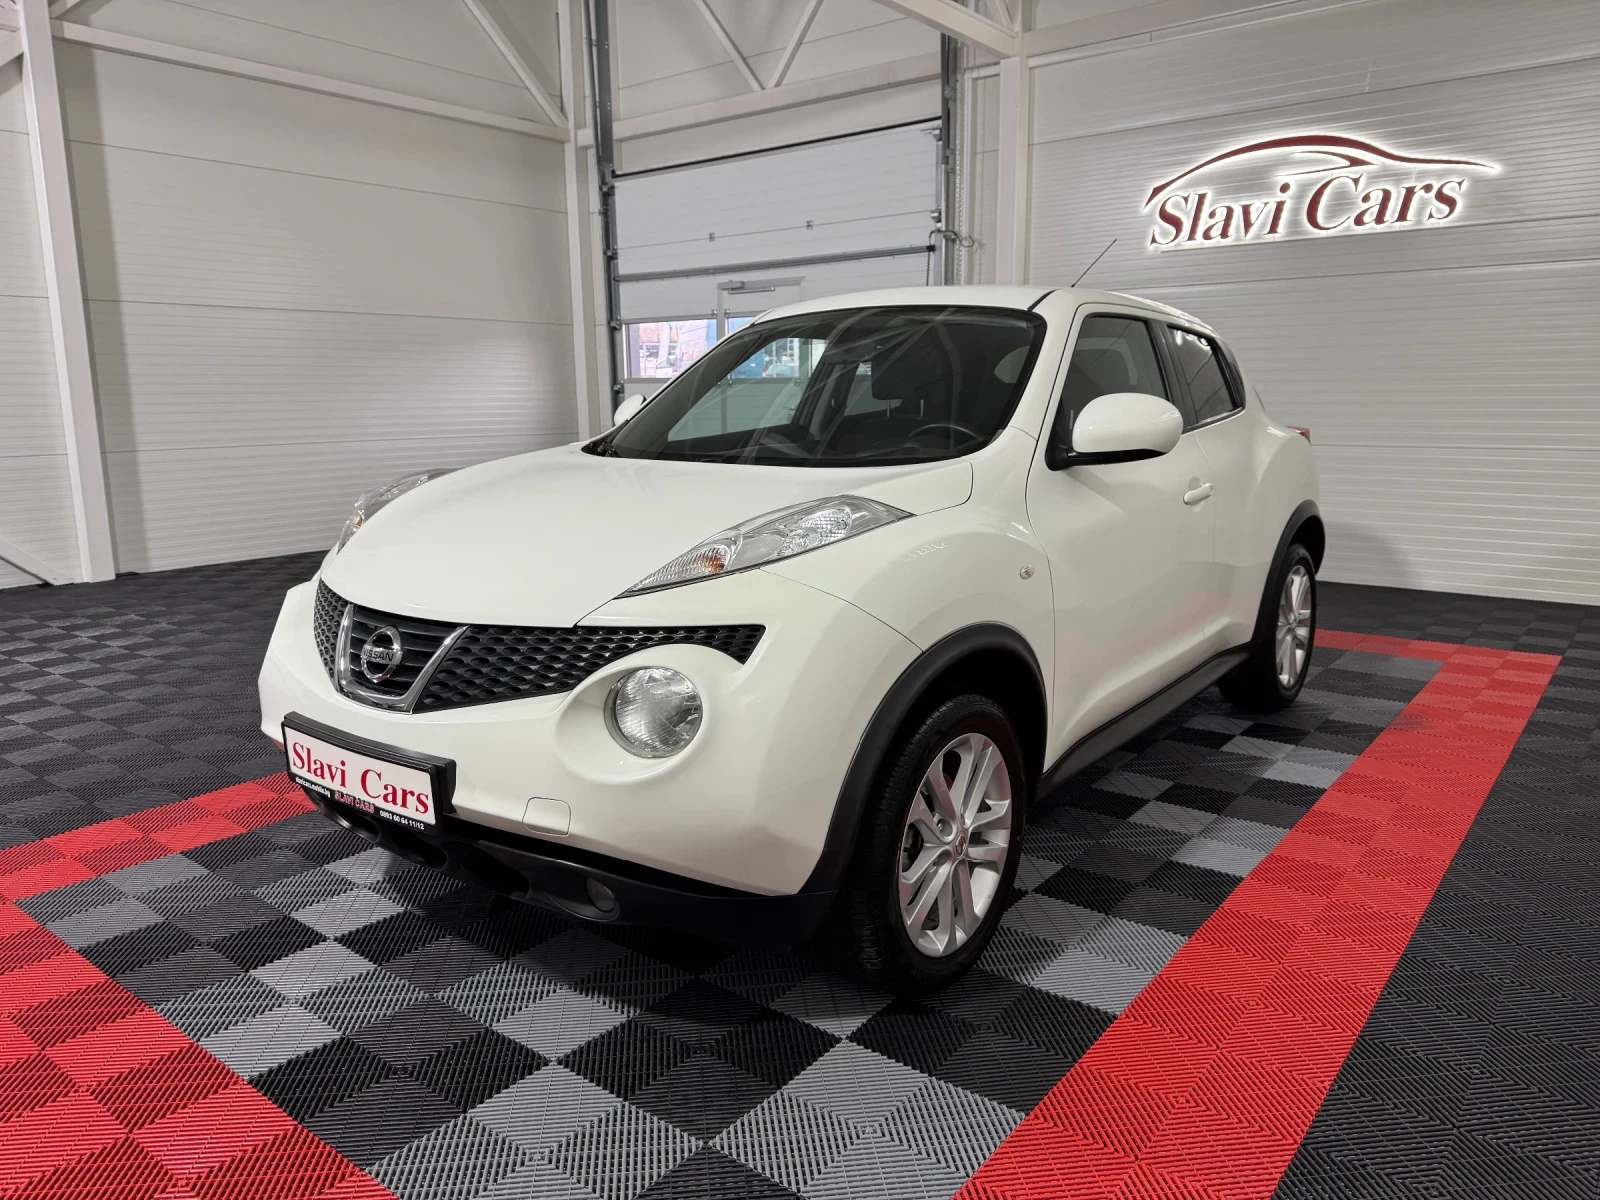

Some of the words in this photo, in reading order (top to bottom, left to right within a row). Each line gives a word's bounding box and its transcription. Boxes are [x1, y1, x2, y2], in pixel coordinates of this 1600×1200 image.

[1150, 181, 1292, 247] Slavi
[1305, 173, 1466, 231] Cars
[292, 741, 347, 788] Slavi
[360, 768, 429, 814] Cars
[334, 791, 354, 806] SLAVI
[355, 798, 375, 813] CARS
[379, 810, 393, 820] 0893
[409, 820, 425, 830] 11/12
